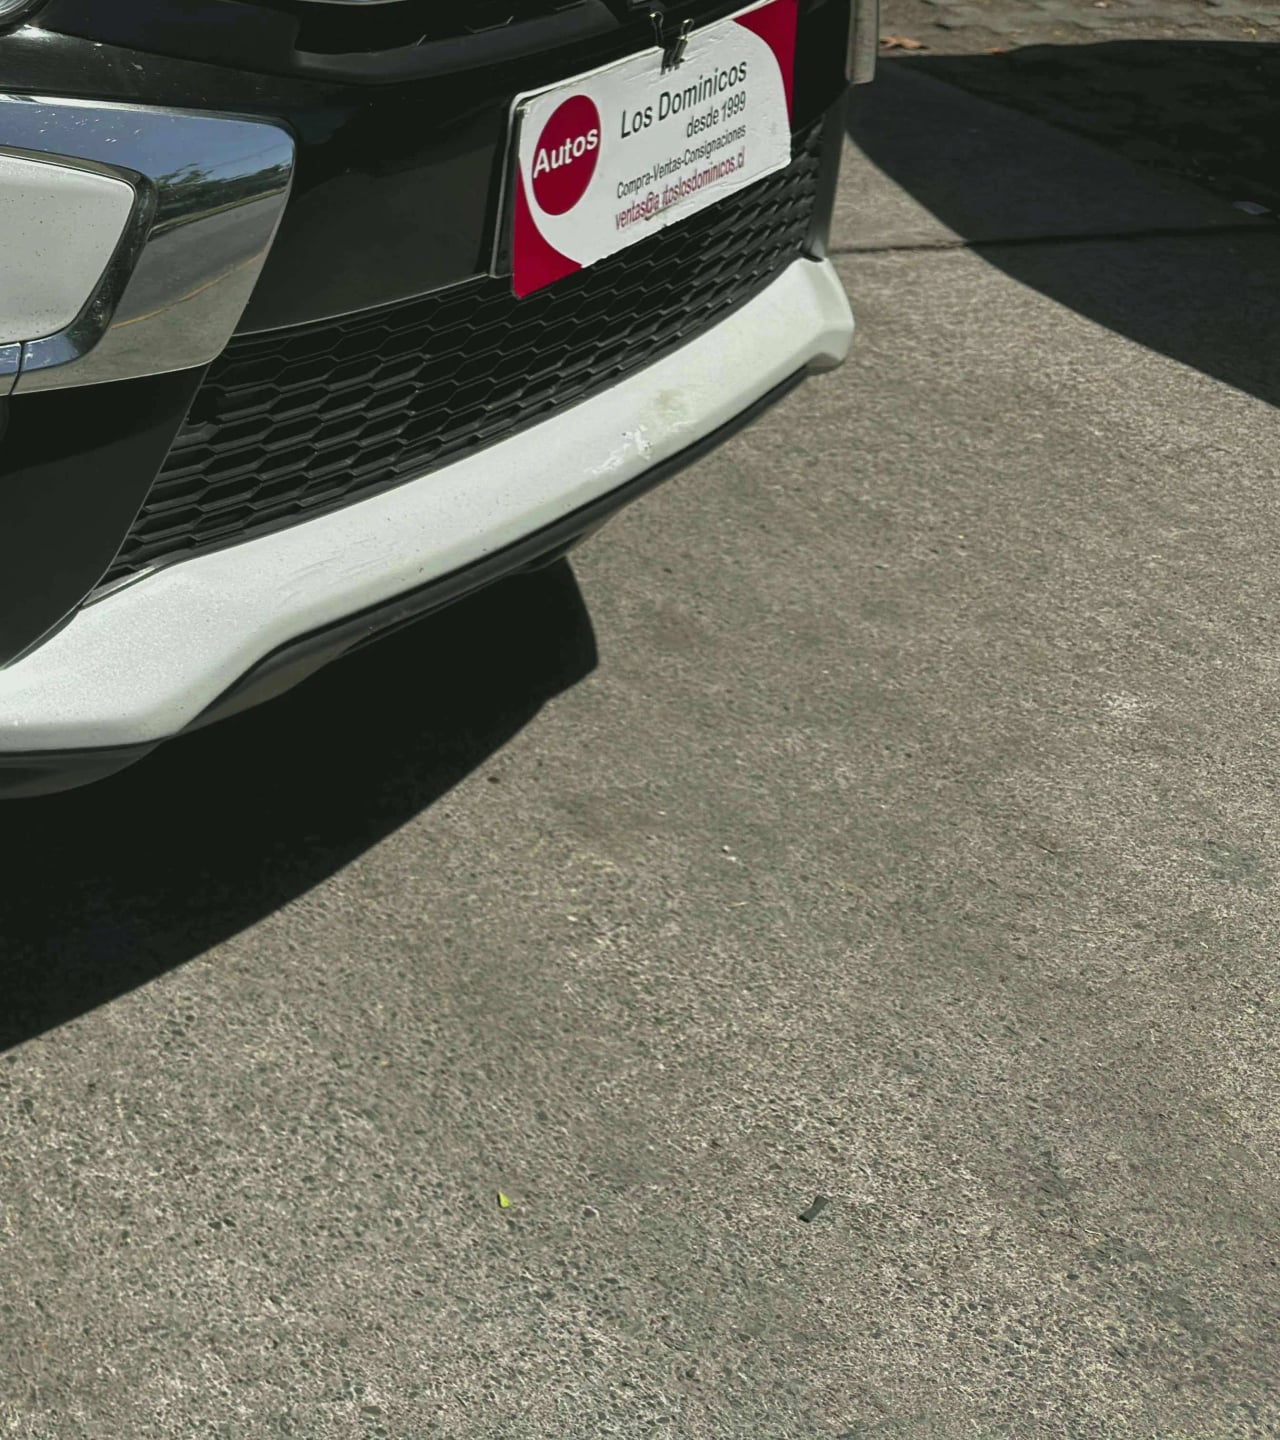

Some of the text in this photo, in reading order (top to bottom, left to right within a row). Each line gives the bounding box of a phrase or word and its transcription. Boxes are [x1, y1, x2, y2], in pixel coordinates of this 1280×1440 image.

[620, 60, 748, 139] Los Dominicos
[686, 90, 746, 138] desde 1999
[532, 127, 599, 179] Autos
[616, 124, 747, 200] Compra-Ventas-Consignaciones
